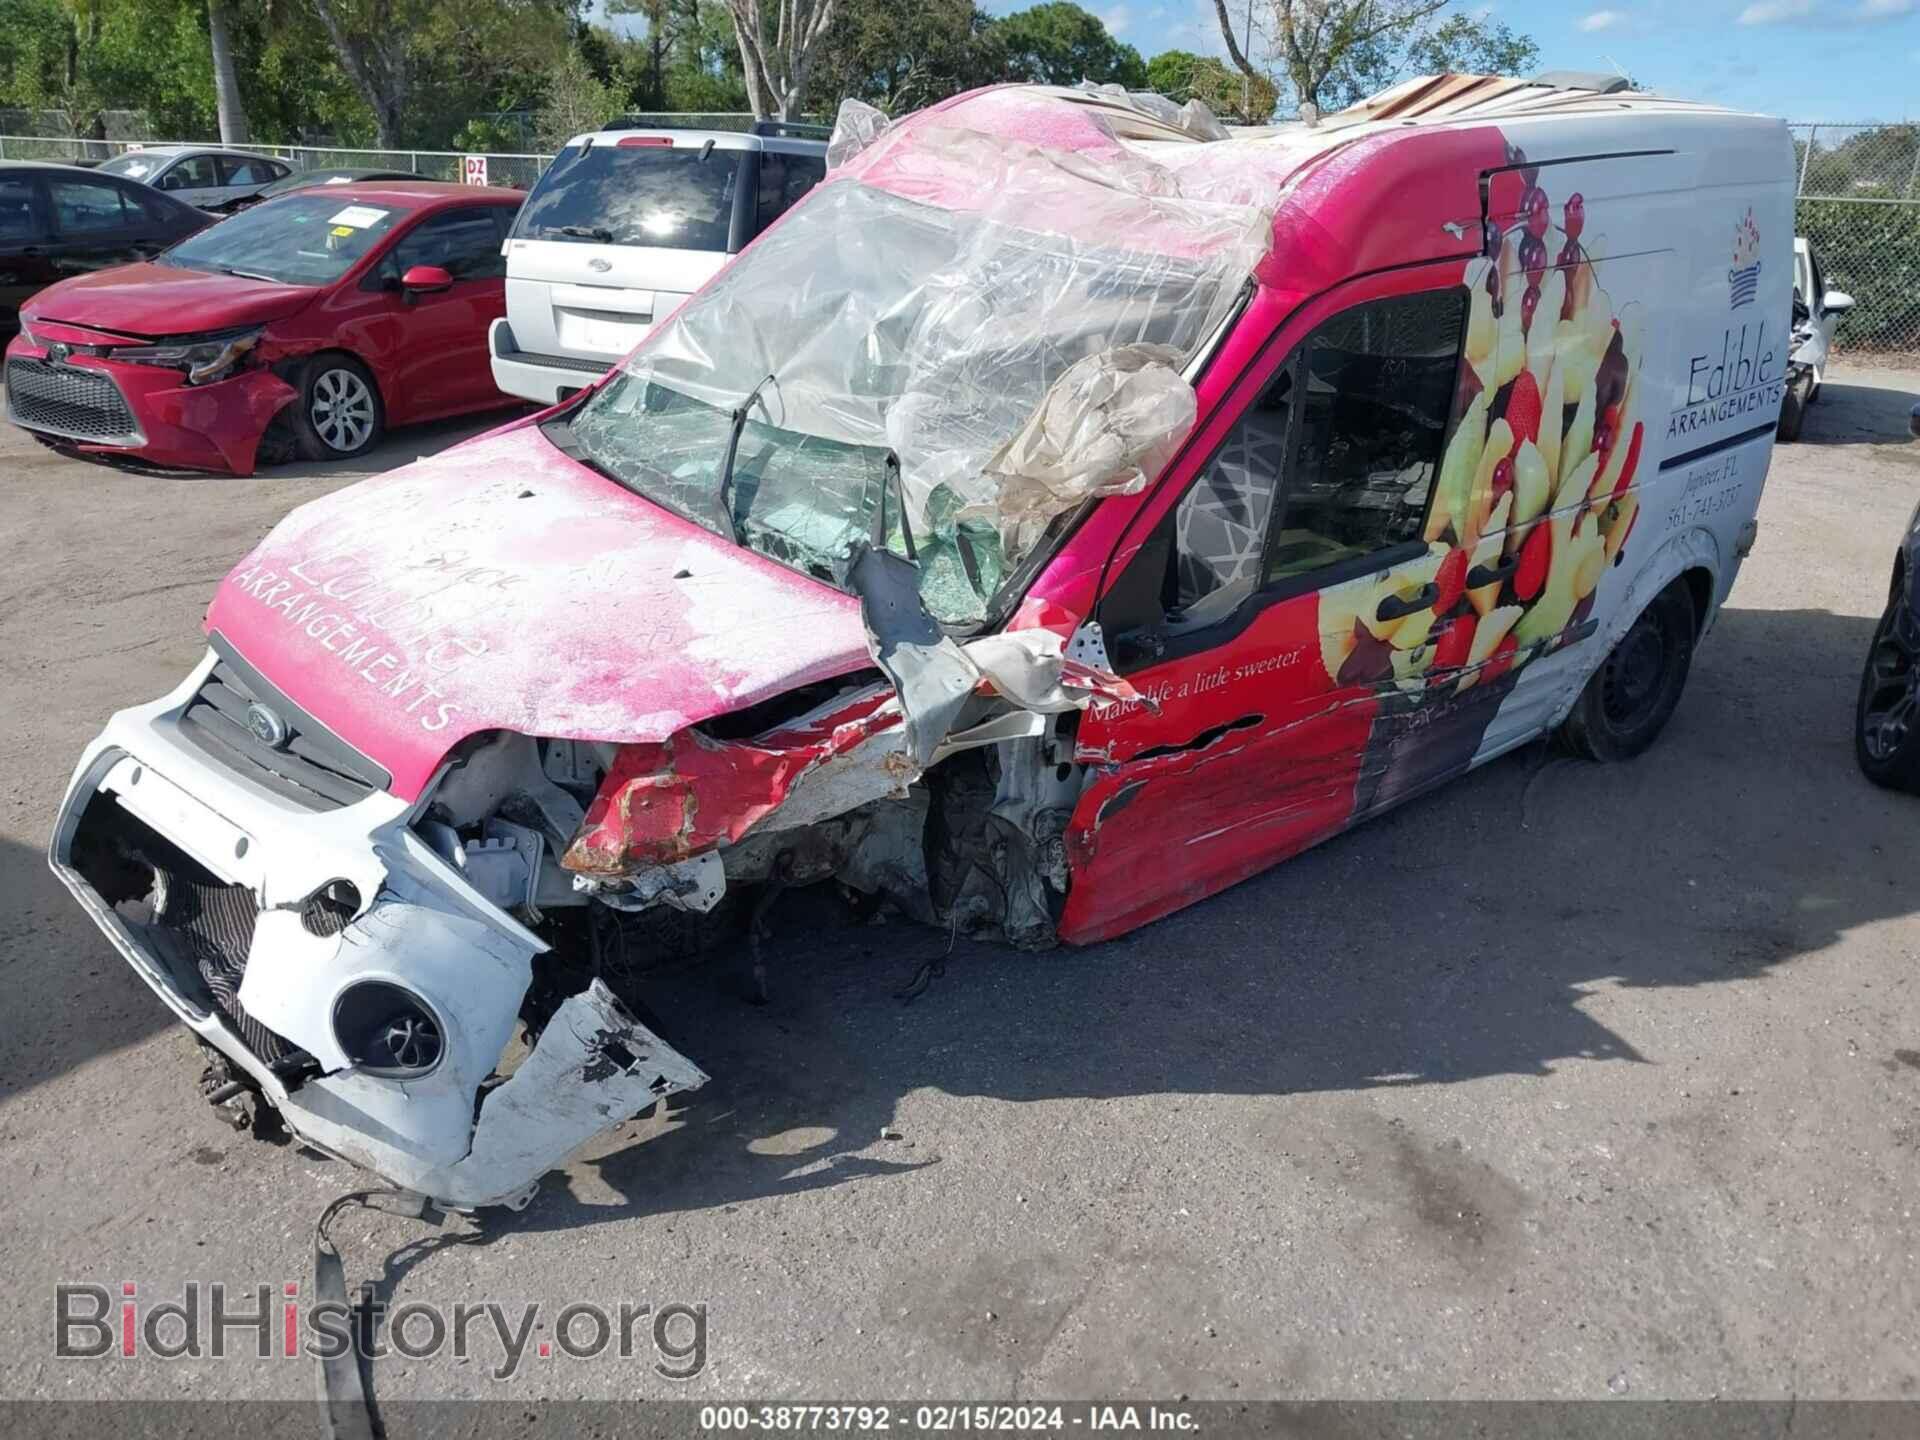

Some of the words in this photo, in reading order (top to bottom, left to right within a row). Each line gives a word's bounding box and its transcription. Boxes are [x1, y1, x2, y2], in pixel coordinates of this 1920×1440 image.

[467, 160, 484, 174] DZ
[1686, 319, 1774, 408] Edible
[1666, 383, 1782, 440] ARRANGEMENTS
[1723, 455, 1738, 480] FL
[231, 566, 463, 732] ARRANGEMENTS
[1088, 697, 1138, 723] Make
[1177, 682, 1189, 698] a
[1193, 665, 1230, 694] little
